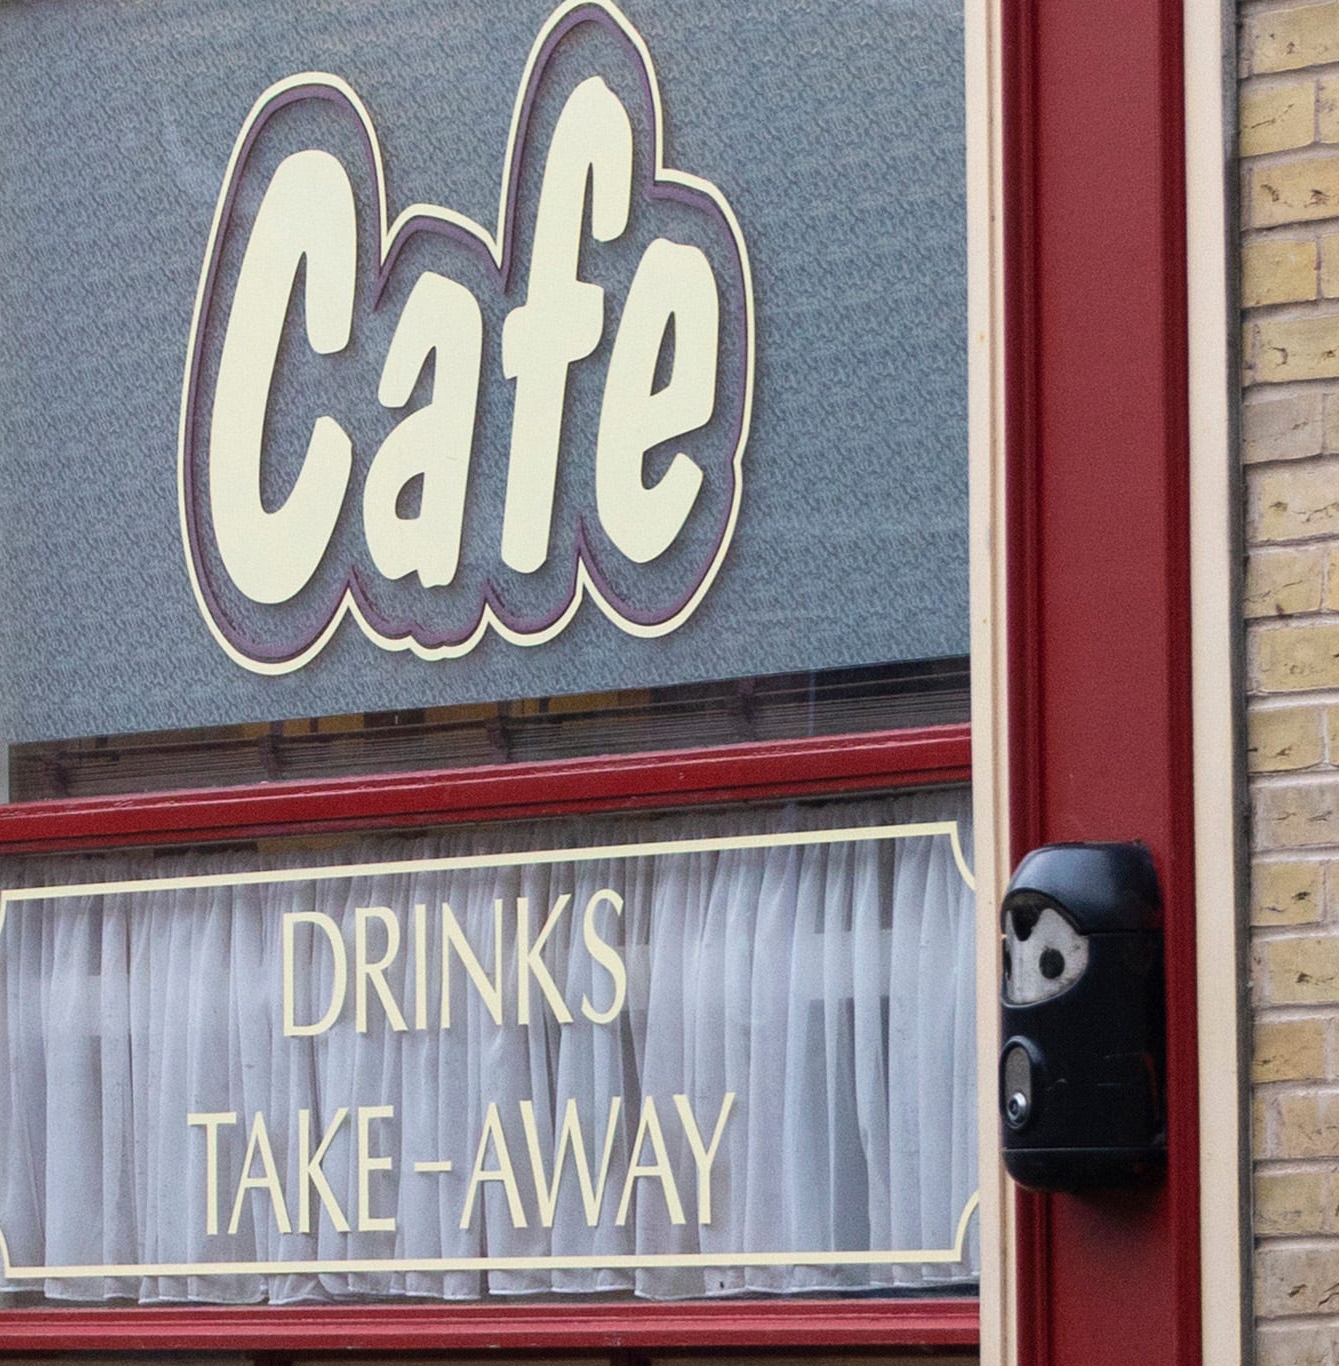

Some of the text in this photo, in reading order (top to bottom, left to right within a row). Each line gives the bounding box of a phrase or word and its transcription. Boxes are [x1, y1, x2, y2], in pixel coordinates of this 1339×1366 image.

[209, 76, 720, 604] Cafe
[282, 888, 626, 1038] DRINKS
[187, 1091, 736, 1236] TAKE-AWAY
